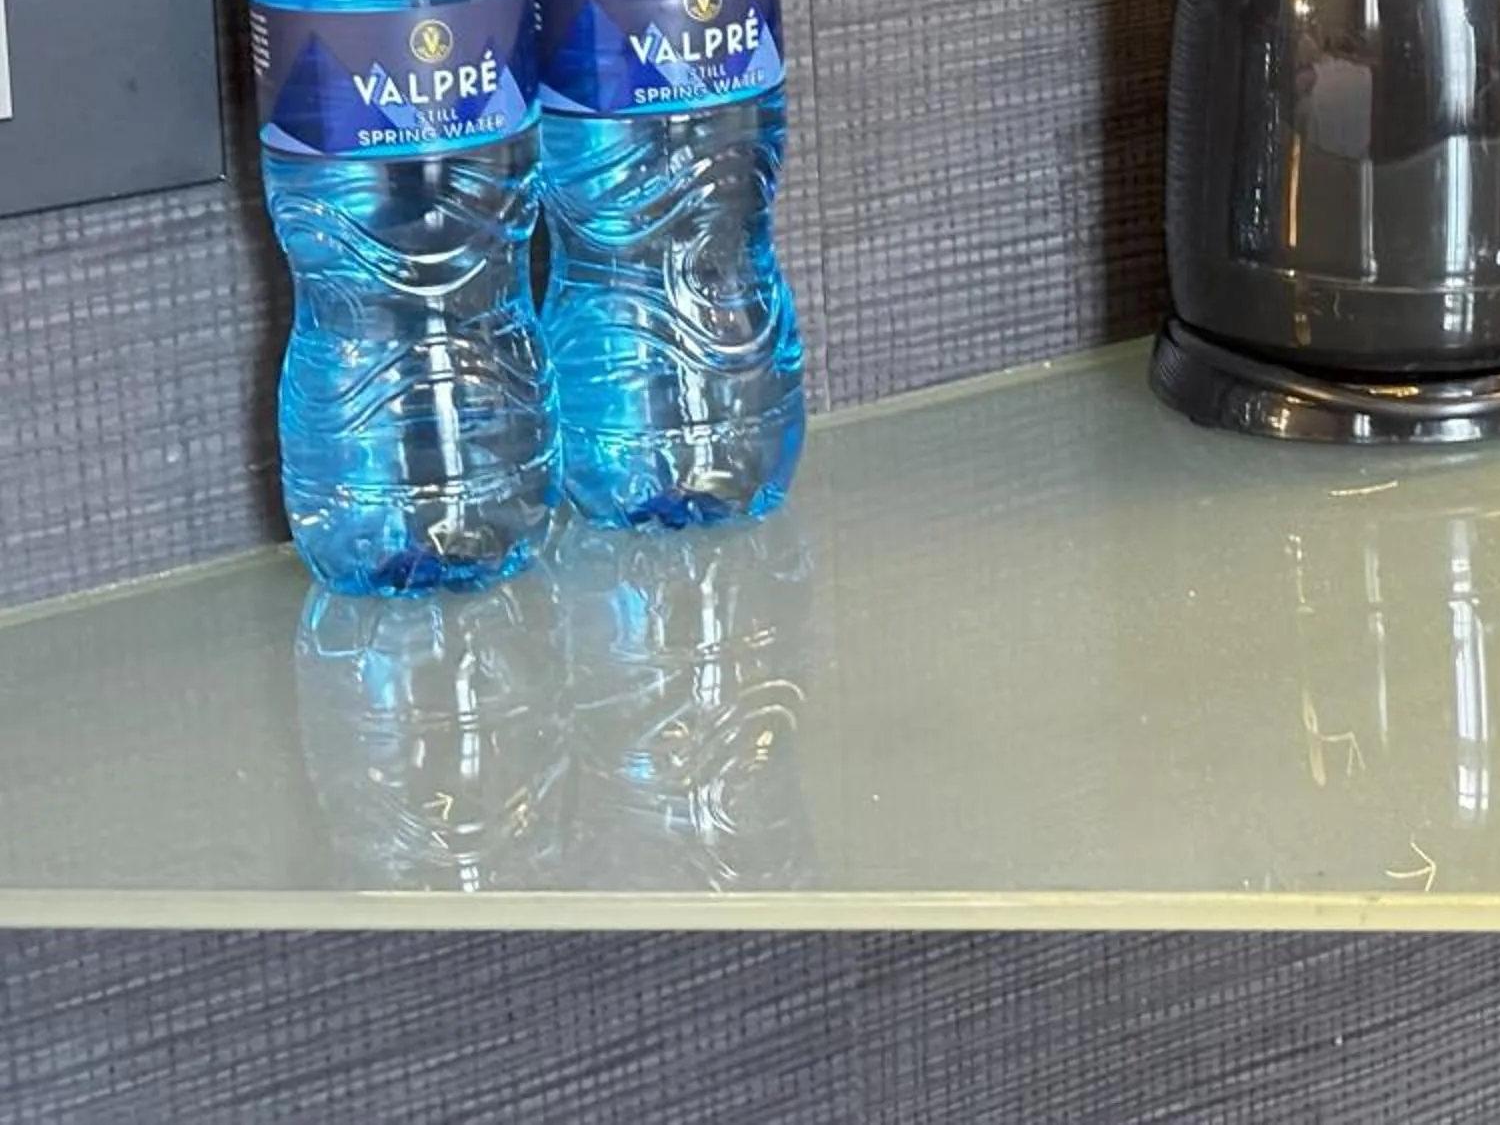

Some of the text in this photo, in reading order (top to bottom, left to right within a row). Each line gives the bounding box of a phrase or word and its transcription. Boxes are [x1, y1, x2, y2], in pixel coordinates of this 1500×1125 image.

[630, 7, 760, 65] VALPRÉ
[353, 50, 498, 106] VALPRÉ
[687, 64, 727, 80] STILL
[634, 82, 707, 104] SPRING
[415, 107, 459, 124] STILL
[357, 113, 506, 147] SPRING WATER
